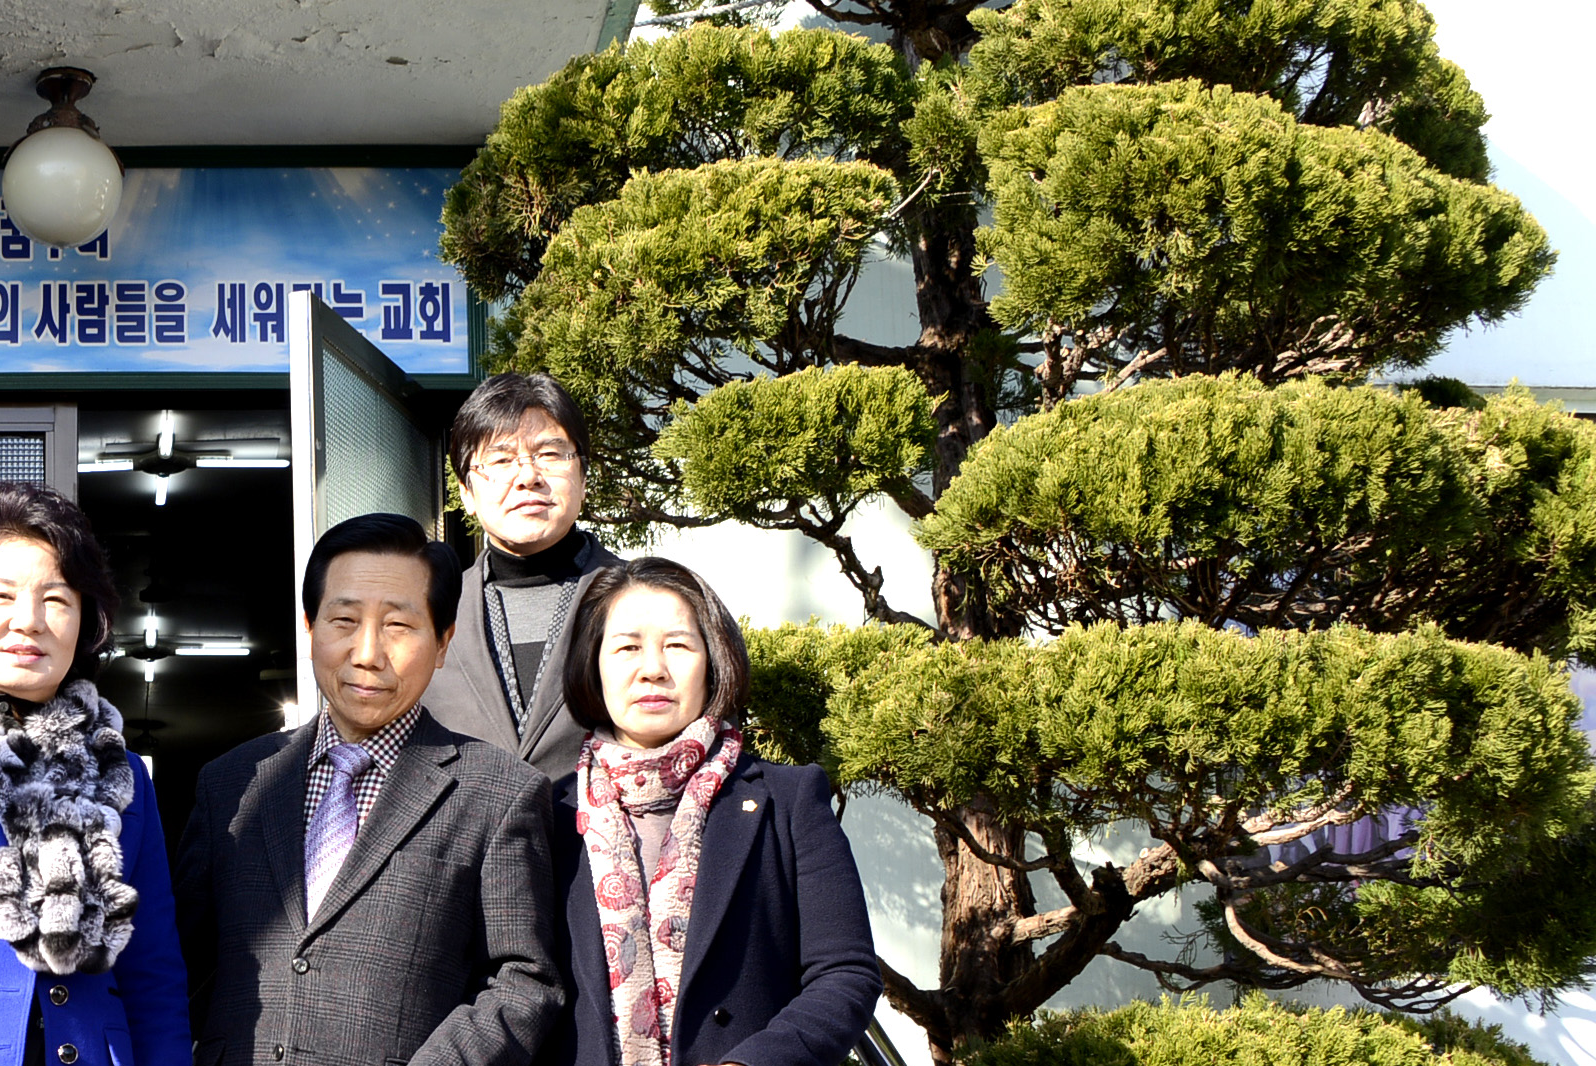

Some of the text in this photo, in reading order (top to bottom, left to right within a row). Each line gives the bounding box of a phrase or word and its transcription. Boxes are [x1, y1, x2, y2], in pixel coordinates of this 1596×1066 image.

[35, 282, 188, 344] 사람들을
[212, 282, 364, 343] 세워는
[381, 282, 451, 343] 교회
